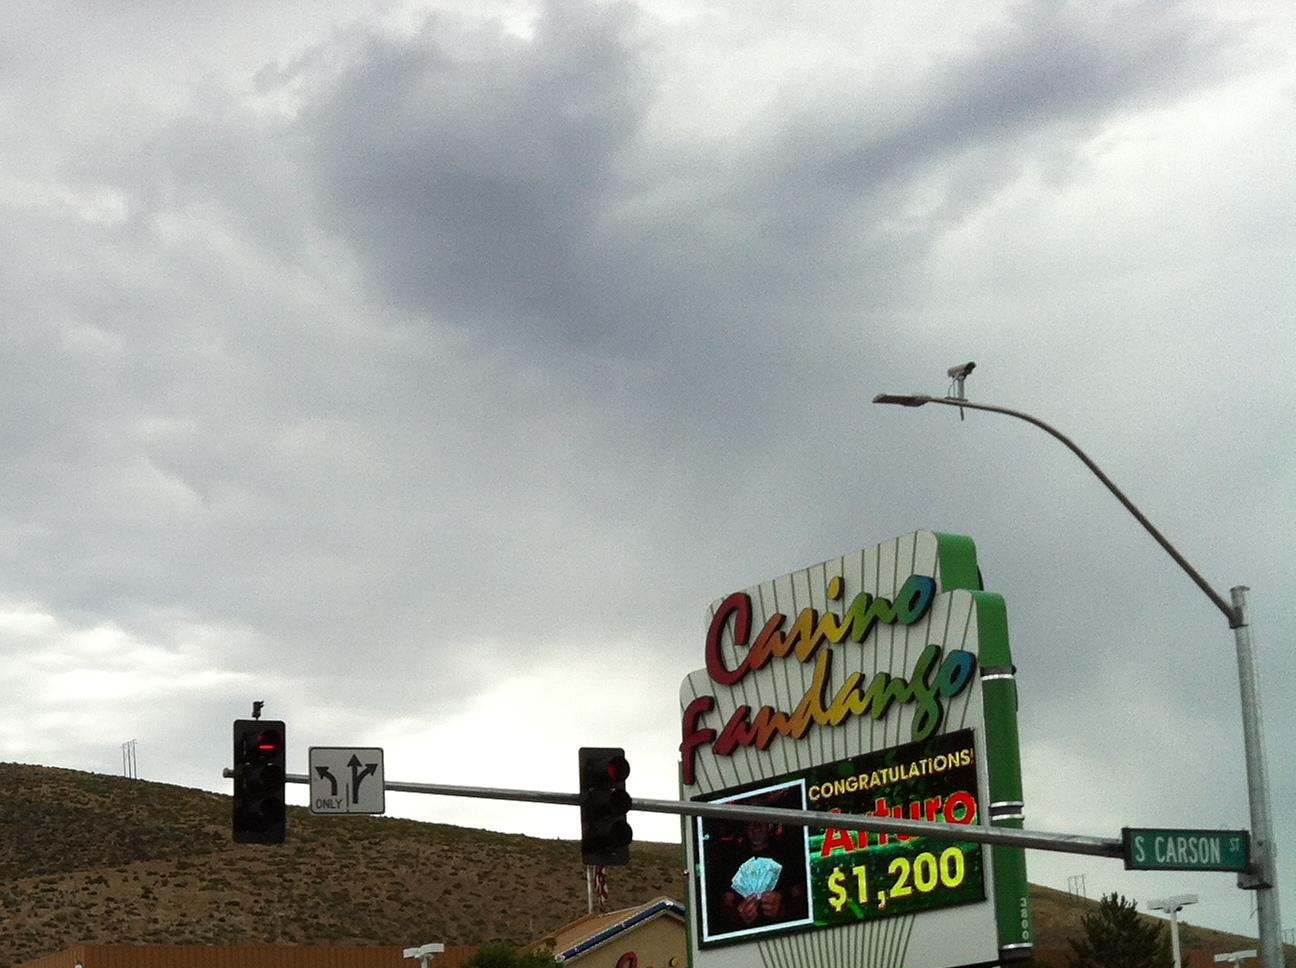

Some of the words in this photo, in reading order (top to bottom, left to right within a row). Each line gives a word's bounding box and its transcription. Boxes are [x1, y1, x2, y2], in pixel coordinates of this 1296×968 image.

[705, 575, 937, 685] Casino
[680, 645, 977, 785] Fandango
[315, 798, 343, 809] ONLY
[820, 790, 977, 857] Arturo
[826, 846, 965, 912] $1,200
[1134, 835, 1146, 863] S
[1154, 836, 1221, 864] CARSON
[1229, 837, 1240, 852] ST
[1019, 897, 1030, 940] 3800
